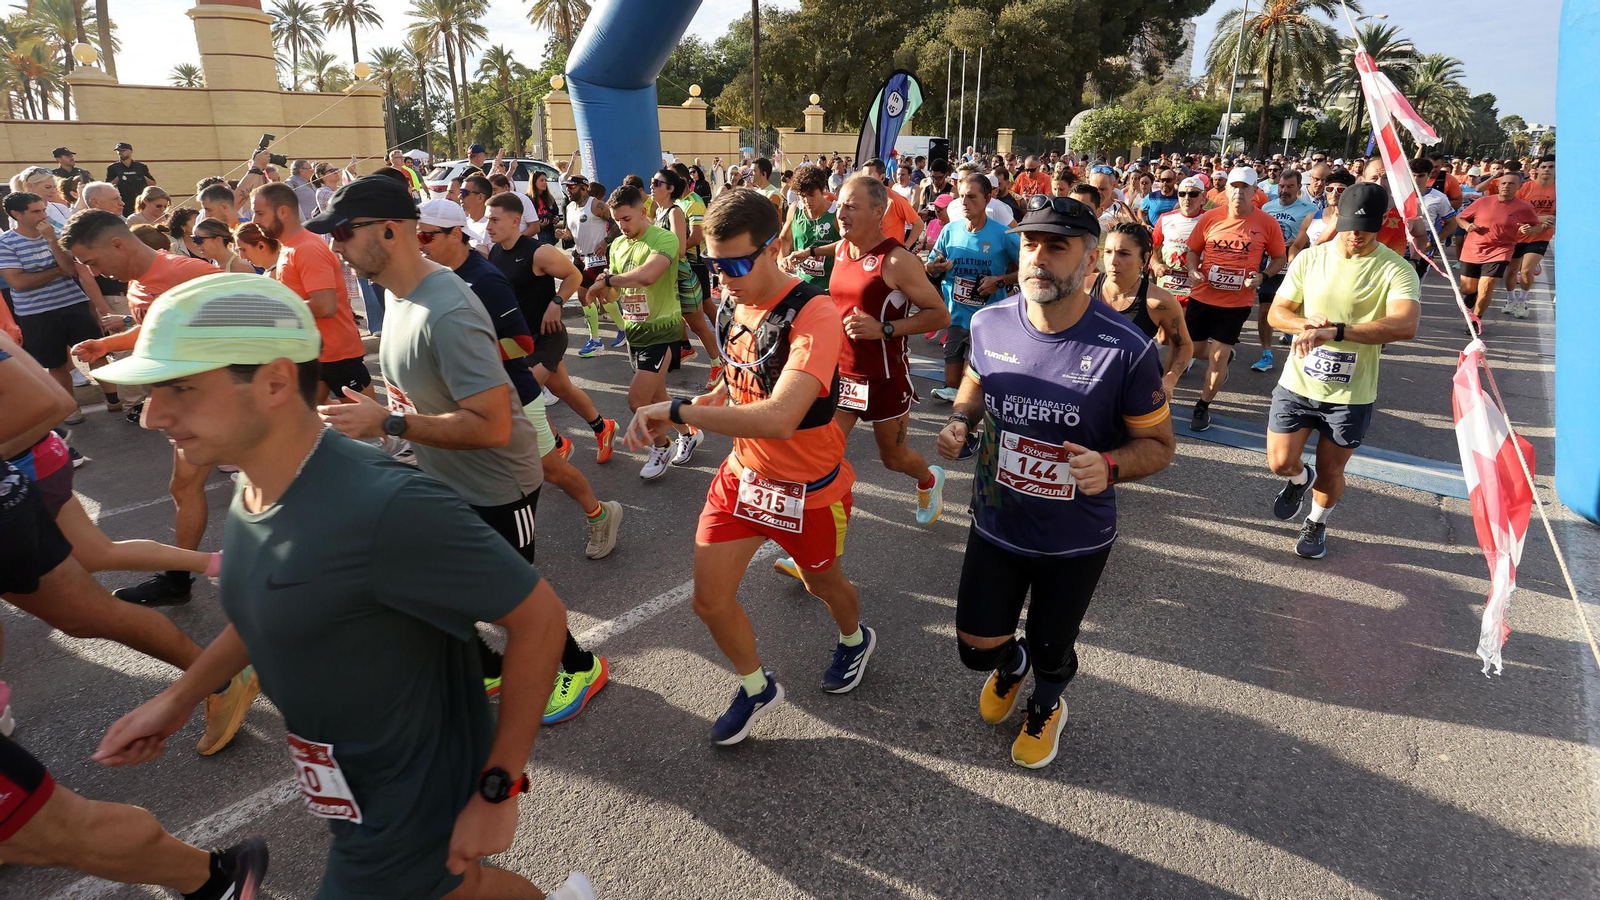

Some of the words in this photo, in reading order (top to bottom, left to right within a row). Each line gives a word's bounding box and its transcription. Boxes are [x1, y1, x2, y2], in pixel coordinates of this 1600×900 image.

[953, 257, 993, 267] ATLETISMO
[954, 267, 978, 275] XEREZ
[1216, 274, 1235, 284] 276
[625, 303, 641, 313] 375
[1314, 359, 1341, 373] 638
[839, 382, 858, 397] 334
[984, 393, 999, 412] EL
[1002, 400, 1081, 427] PUERTO
[1004, 394, 1032, 405] MEDIA
[1033, 399, 1080, 413] MARATÓN
[1001, 414, 1030, 426] NAVAL
[1018, 456, 1058, 482] 144
[753, 488, 786, 513] 315
